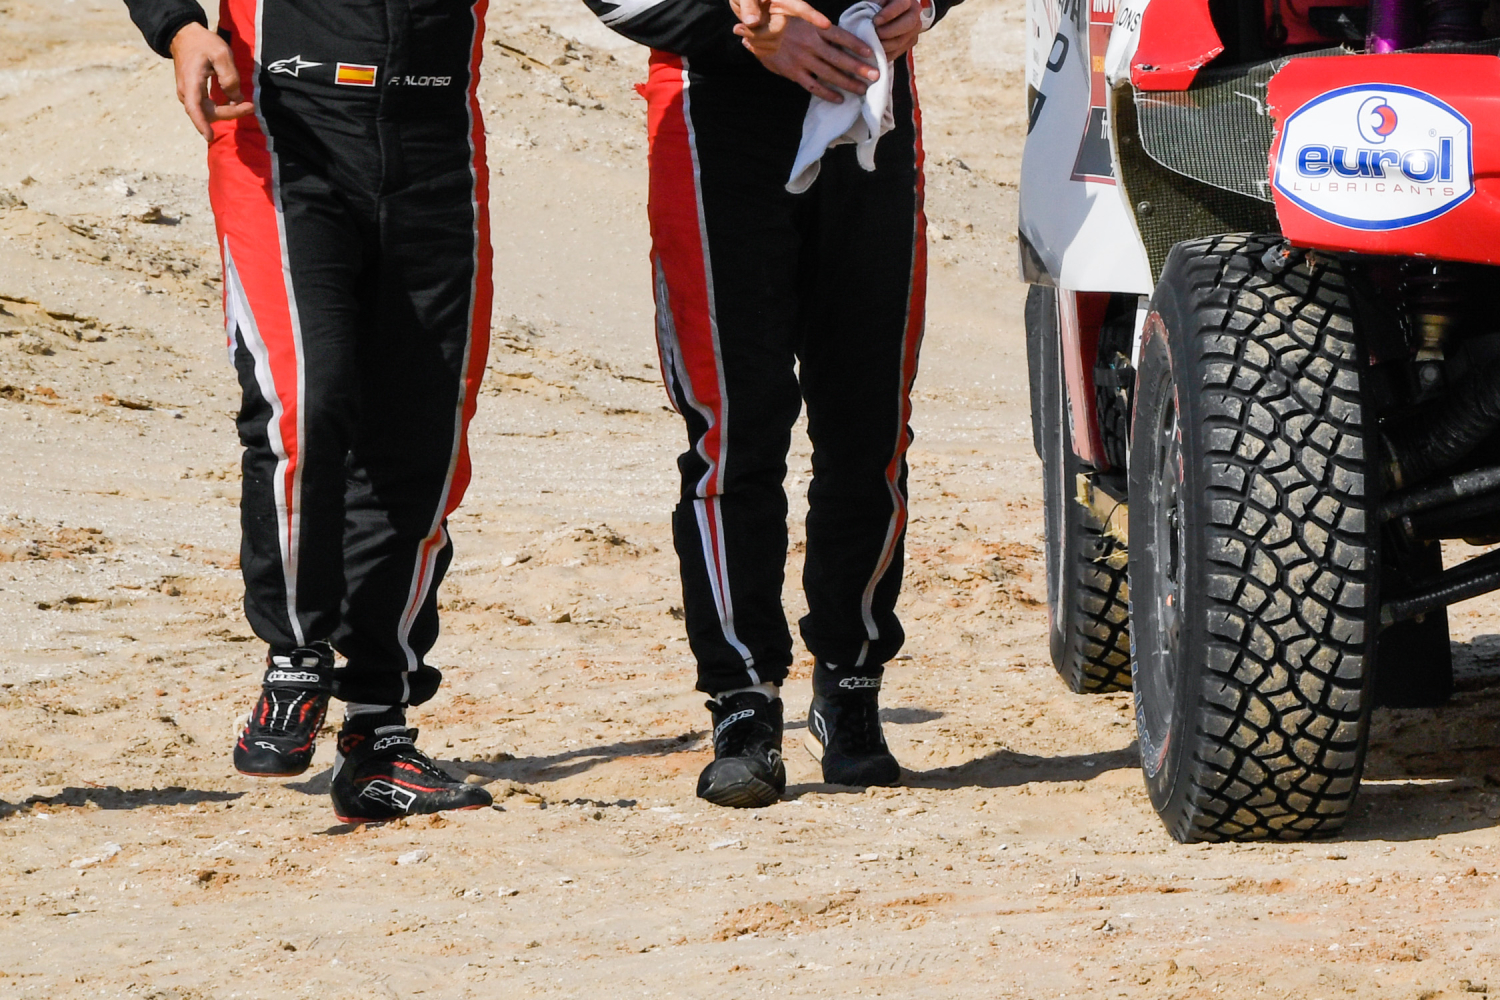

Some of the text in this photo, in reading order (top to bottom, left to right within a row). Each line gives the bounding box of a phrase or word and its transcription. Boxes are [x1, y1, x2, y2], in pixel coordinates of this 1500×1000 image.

[388, 75, 452, 87] F. ALONSO
[1297, 136, 1455, 184] eurol
[1293, 183, 1455, 198] LUBRICANTS
